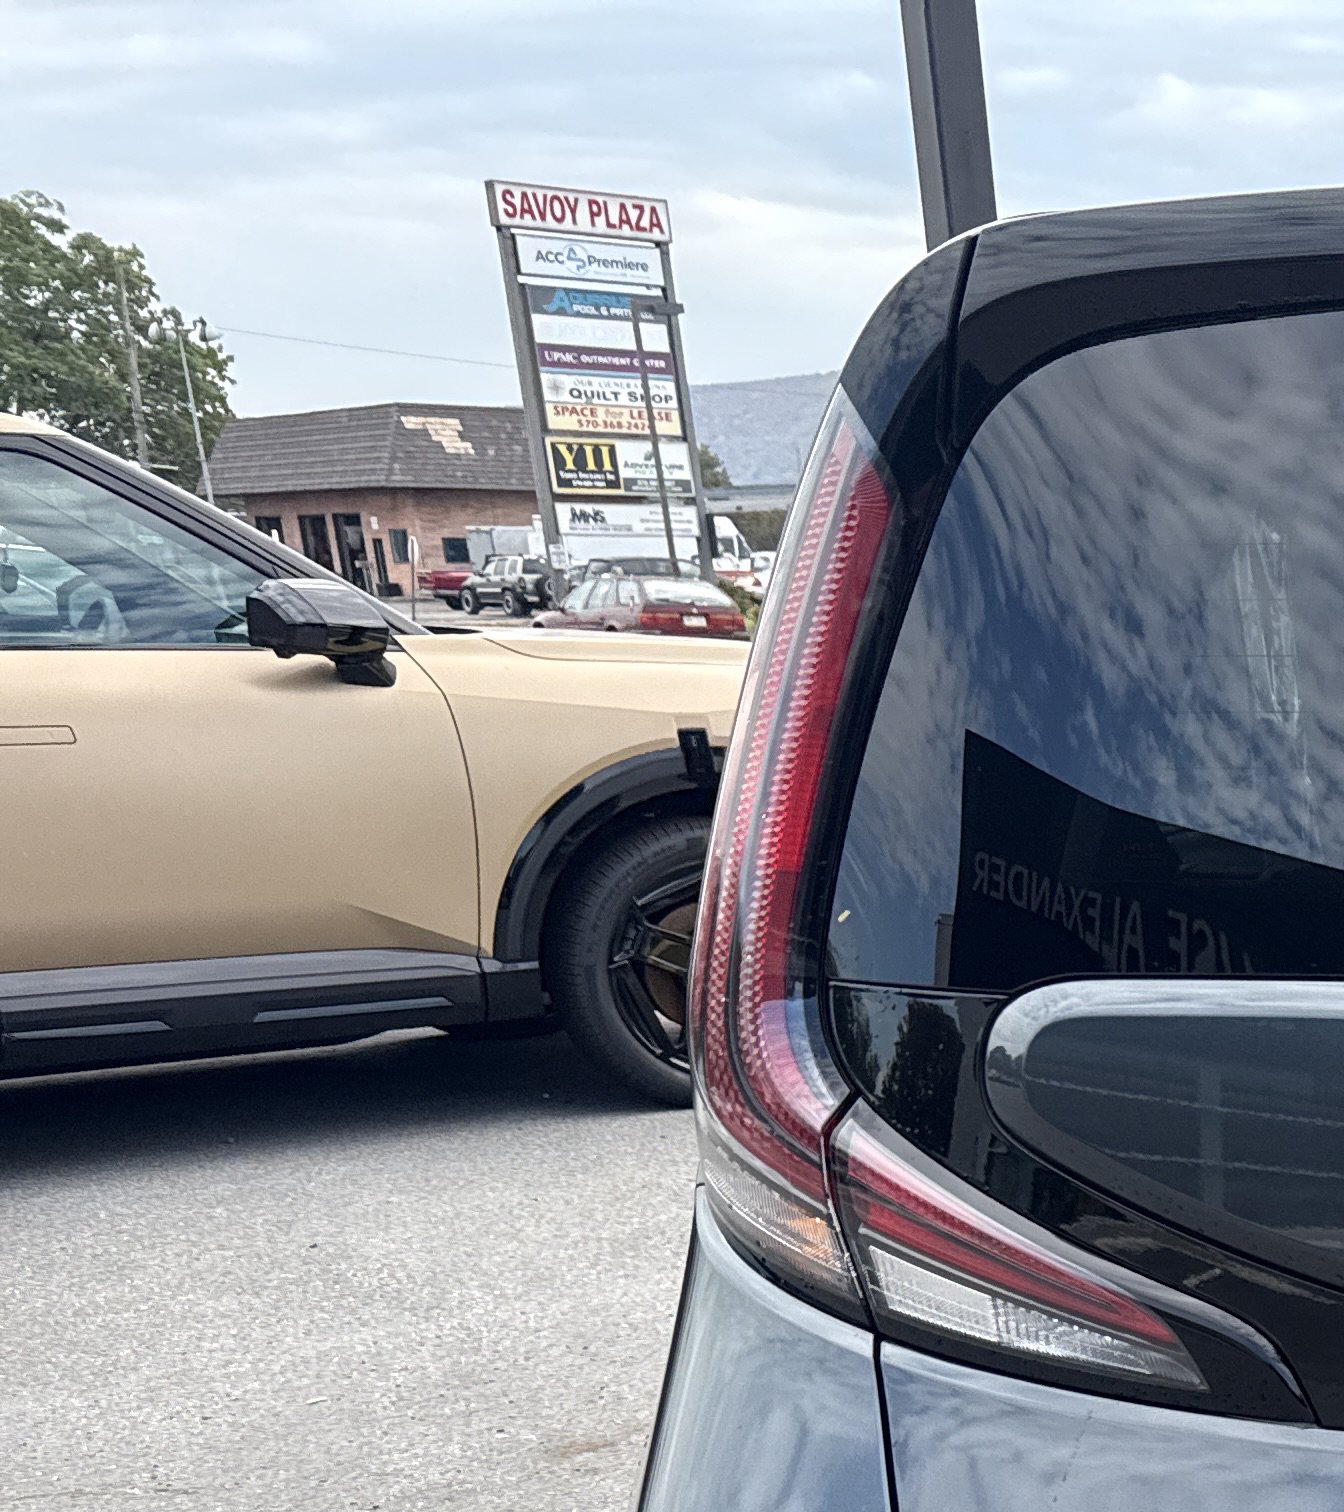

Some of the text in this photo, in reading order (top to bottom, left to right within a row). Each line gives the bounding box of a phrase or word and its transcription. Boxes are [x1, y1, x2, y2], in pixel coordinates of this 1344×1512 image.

[501, 188, 665, 235] SAVOY PLAZA
[535, 249, 649, 273] ACC Premiere
[544, 350, 666, 369] UPMC OUTPATIENT CNTER
[568, 387, 621, 402] QUILT
[553, 404, 598, 419] SPACE
[629, 409, 673, 423] LESE
[577, 419, 652, 432] 570-368-242
[623, 460, 685, 471] ADVENURE
